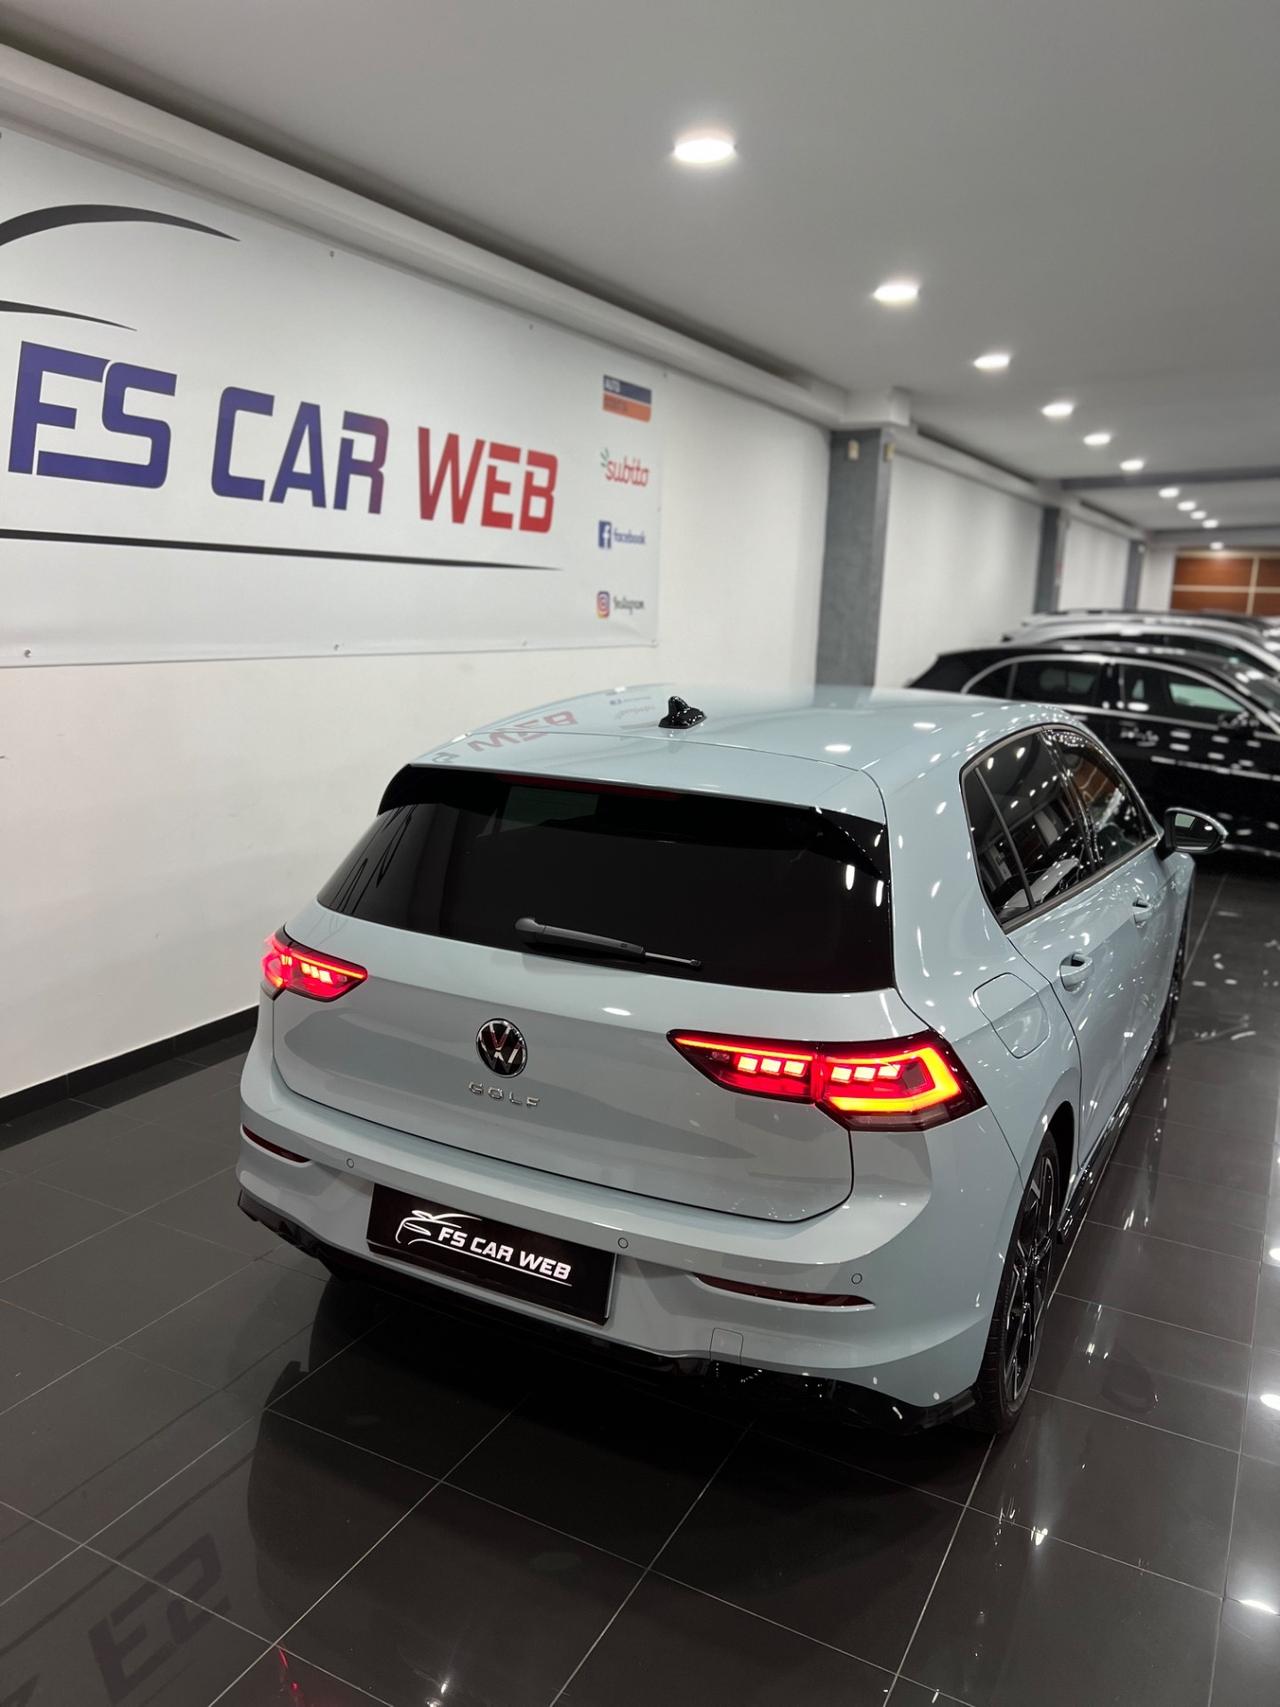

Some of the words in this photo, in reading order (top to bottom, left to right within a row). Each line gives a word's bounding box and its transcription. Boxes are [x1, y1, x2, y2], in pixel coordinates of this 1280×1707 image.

[8, 340, 178, 489] FS
[211, 386, 390, 515] CAR
[417, 426, 559, 533] WEB
[604, 456, 649, 487] subito
[613, 528, 646, 545] facebook
[613, 596, 645, 615] Instagram
[468, 1081, 540, 1108] GOLF
[437, 1226, 468, 1248] FS
[470, 1236, 514, 1262] CAR
[519, 1250, 572, 1280] WEB
